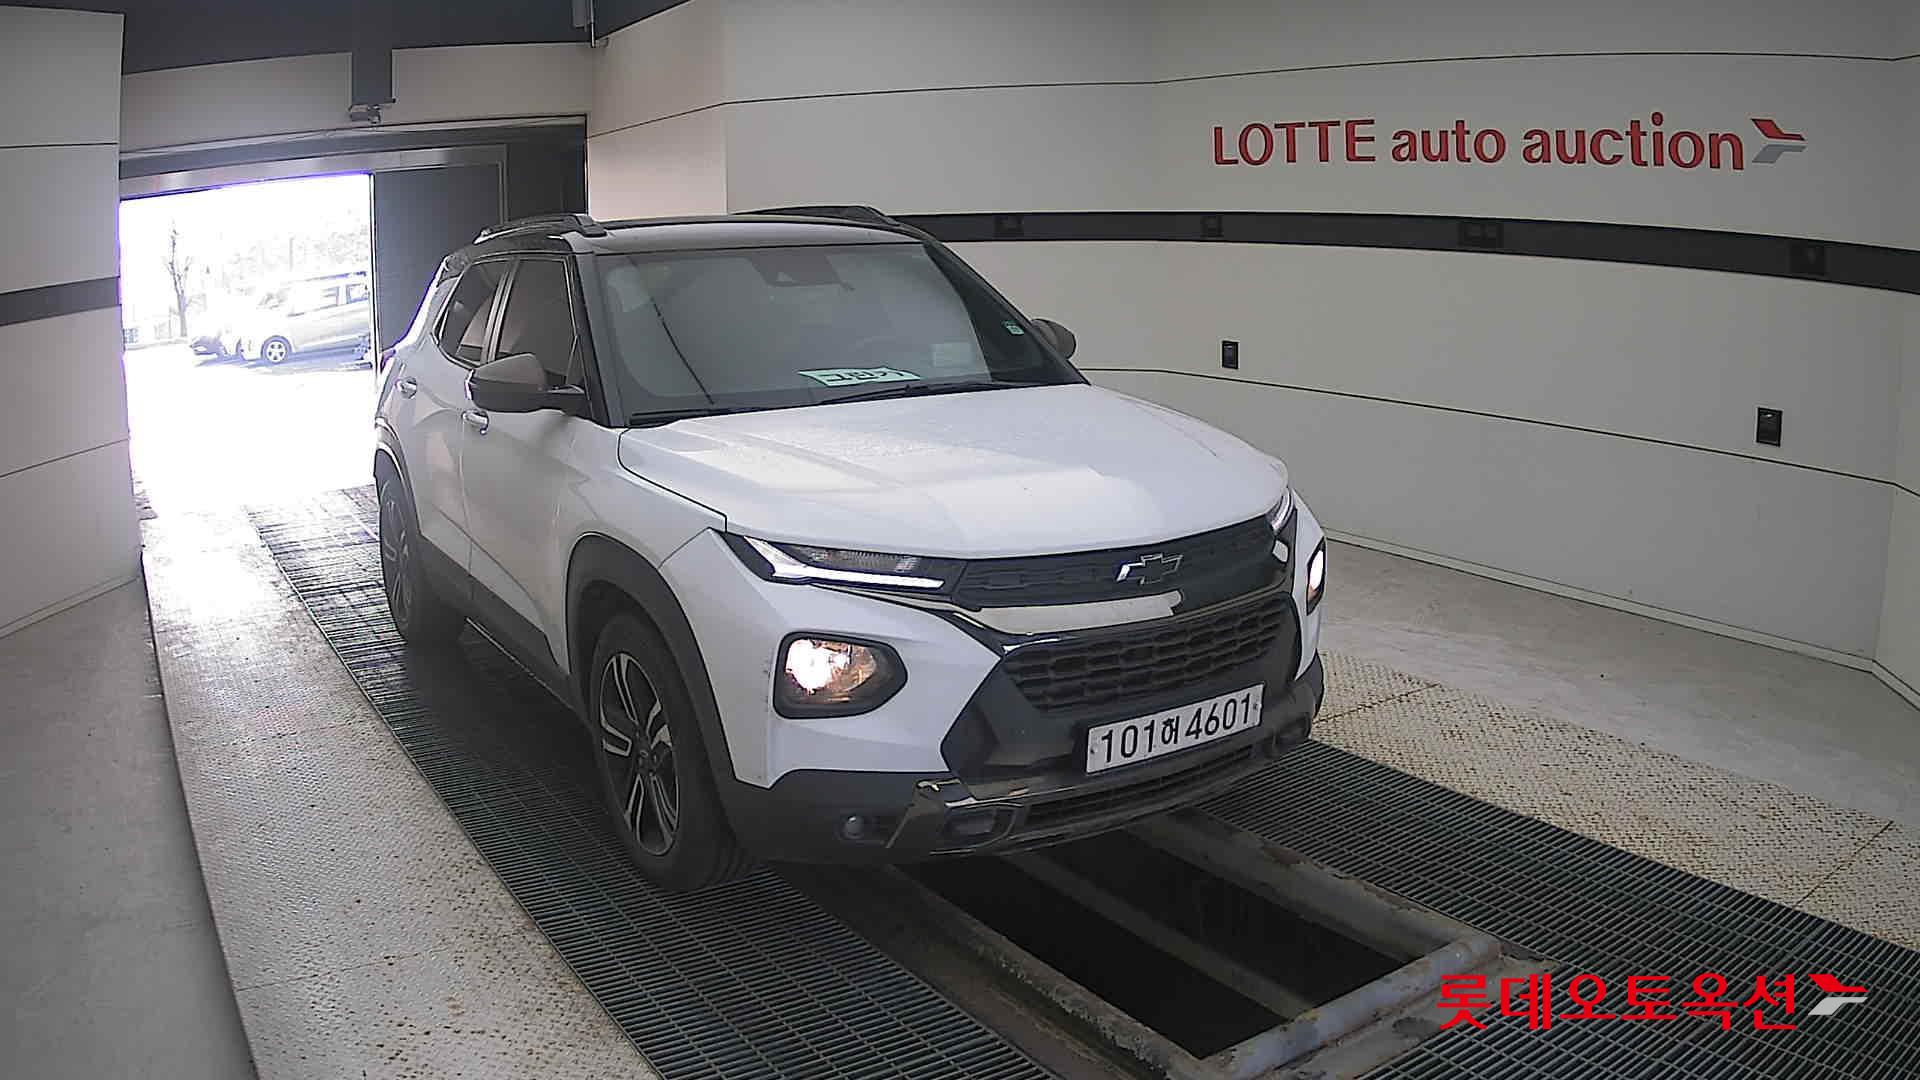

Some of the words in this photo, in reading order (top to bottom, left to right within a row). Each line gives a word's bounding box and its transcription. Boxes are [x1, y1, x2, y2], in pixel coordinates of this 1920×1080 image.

[1213, 118, 1377, 166] LOTTE
[1390, 118, 1508, 165] auto
[1521, 110, 1745, 171] auction
